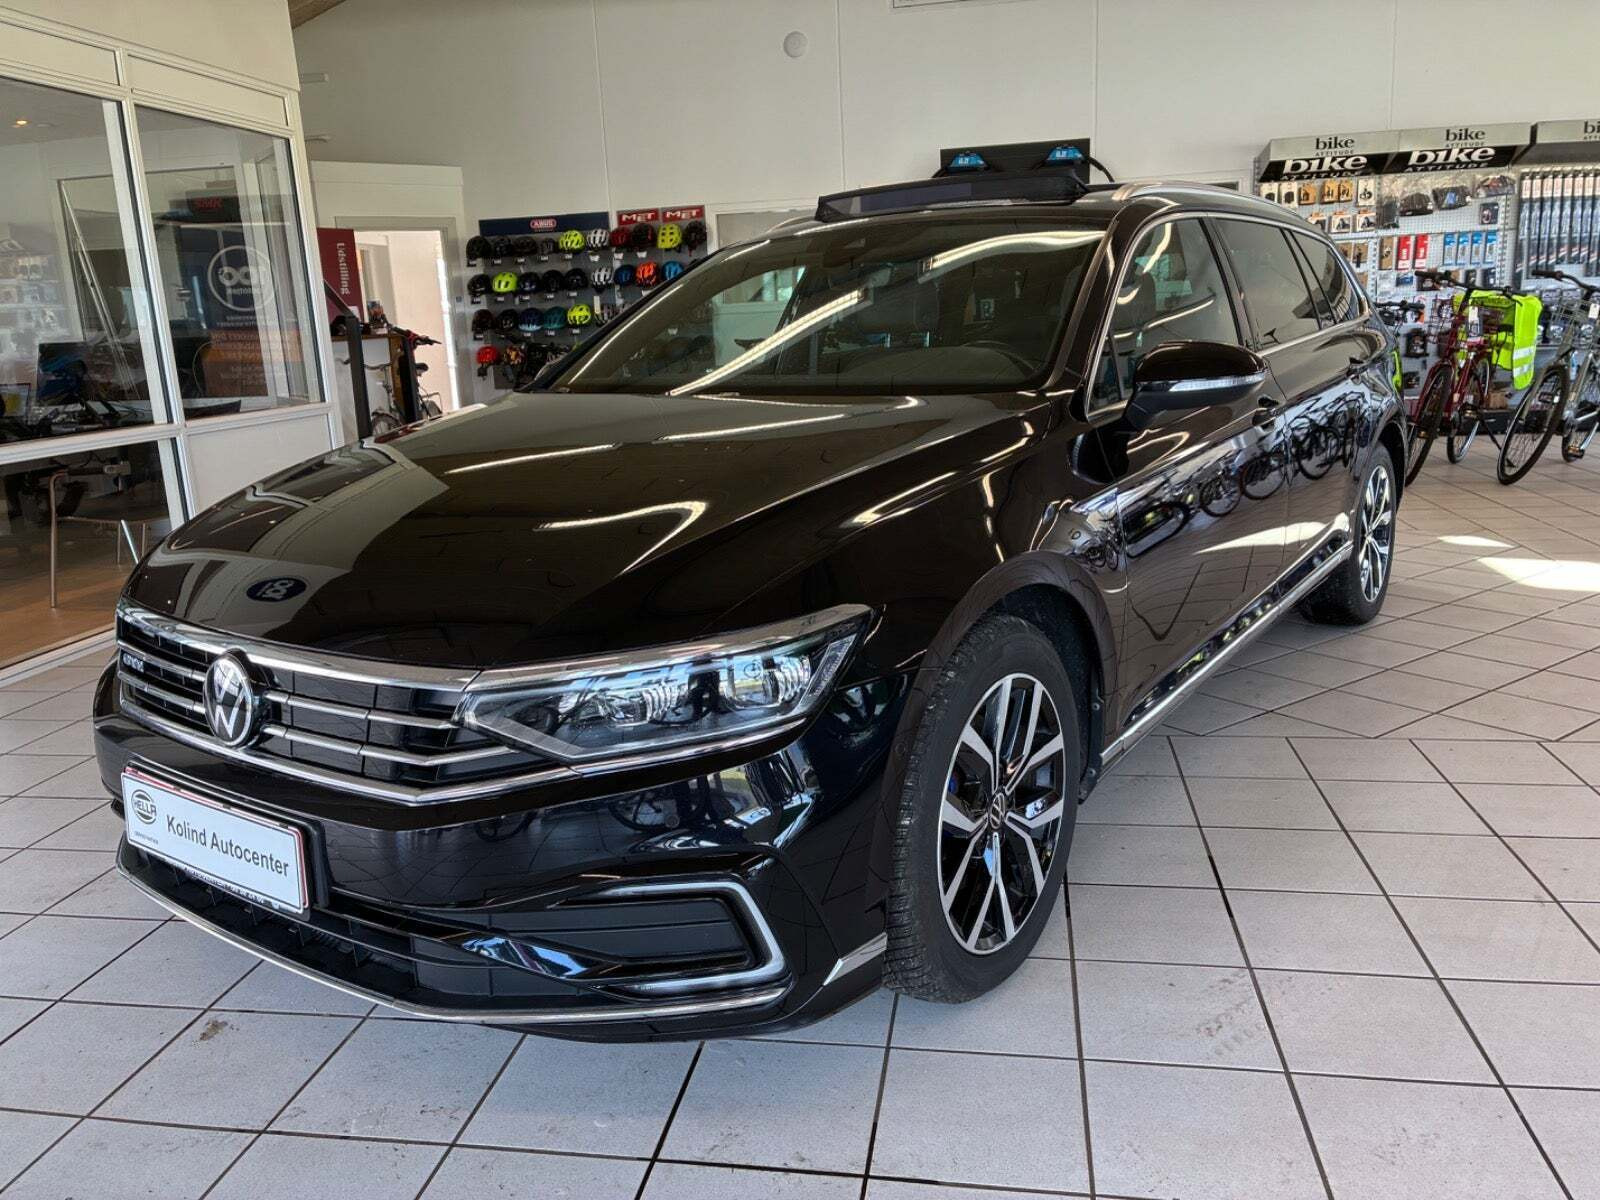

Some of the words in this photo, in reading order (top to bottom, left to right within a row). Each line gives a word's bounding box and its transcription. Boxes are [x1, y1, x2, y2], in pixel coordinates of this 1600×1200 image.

[1445, 127, 1486, 142] bike
[1315, 137, 1355, 150] bike
[1282, 155, 1368, 175] bike
[1408, 147, 1495, 166] bike
[621, 212, 656, 222] MET
[664, 208, 700, 218] MET
[336, 242, 351, 295] Udstilling
[166, 814, 207, 847] Kolind
[210, 832, 289, 877] Autocenter
